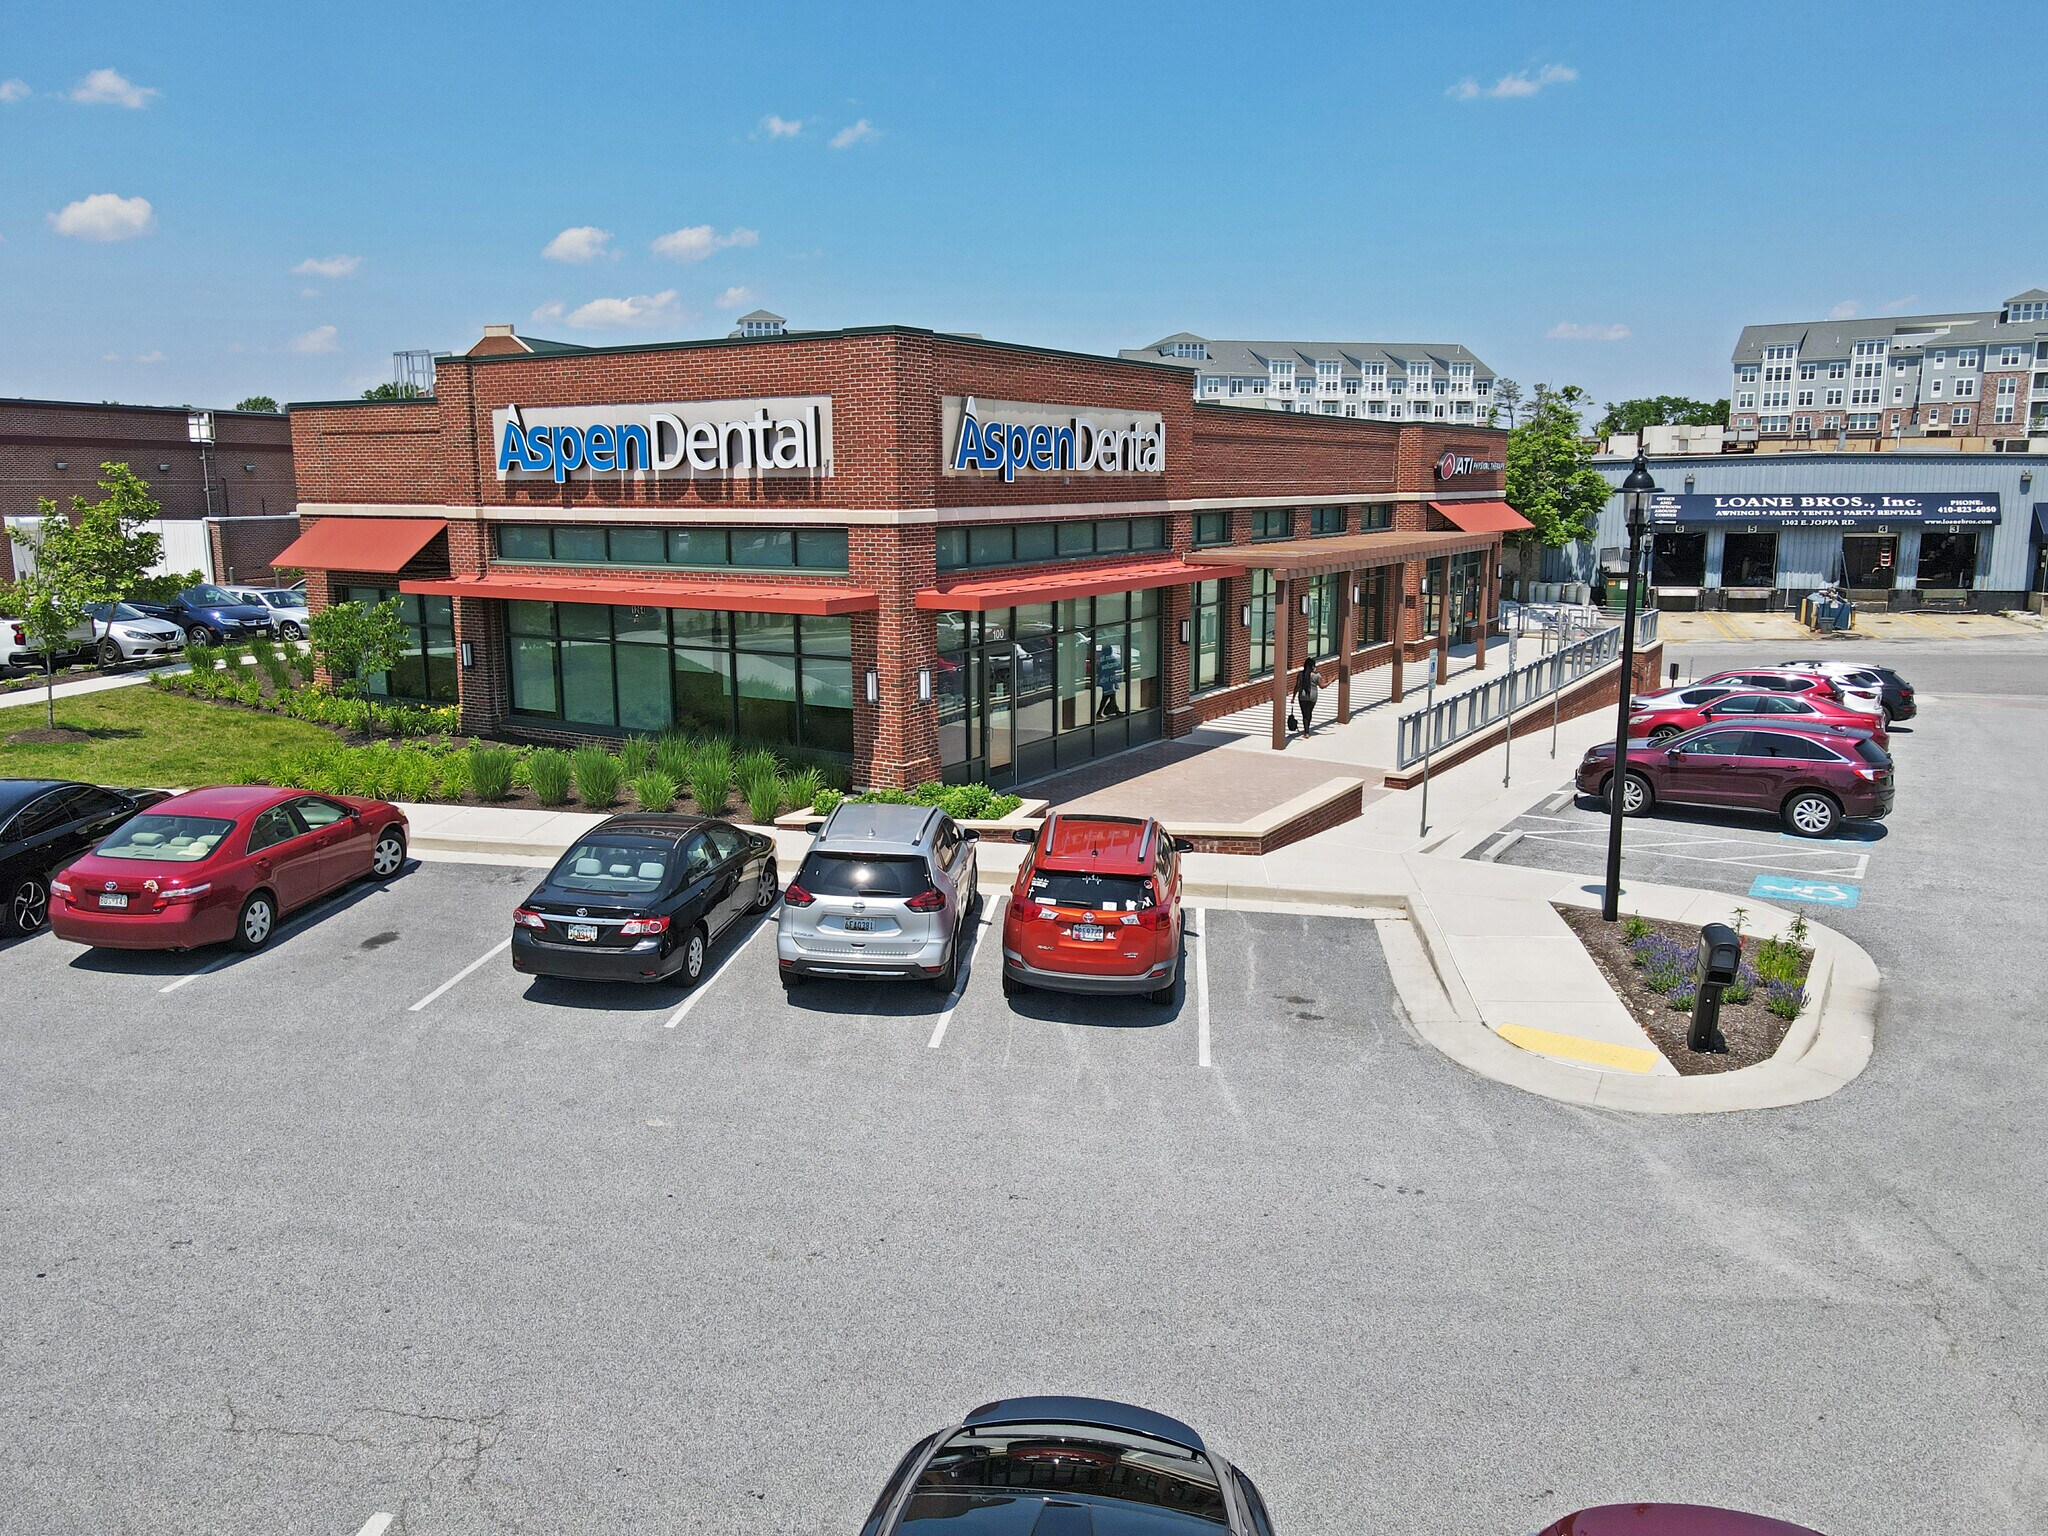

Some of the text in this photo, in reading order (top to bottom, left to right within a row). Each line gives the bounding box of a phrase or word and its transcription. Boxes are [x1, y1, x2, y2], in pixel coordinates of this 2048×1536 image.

[1454, 457, 1473, 474] ATI
[1714, 496, 1923, 508] LOANE BROS., Inc.
[992, 628, 1004, 640] 100
